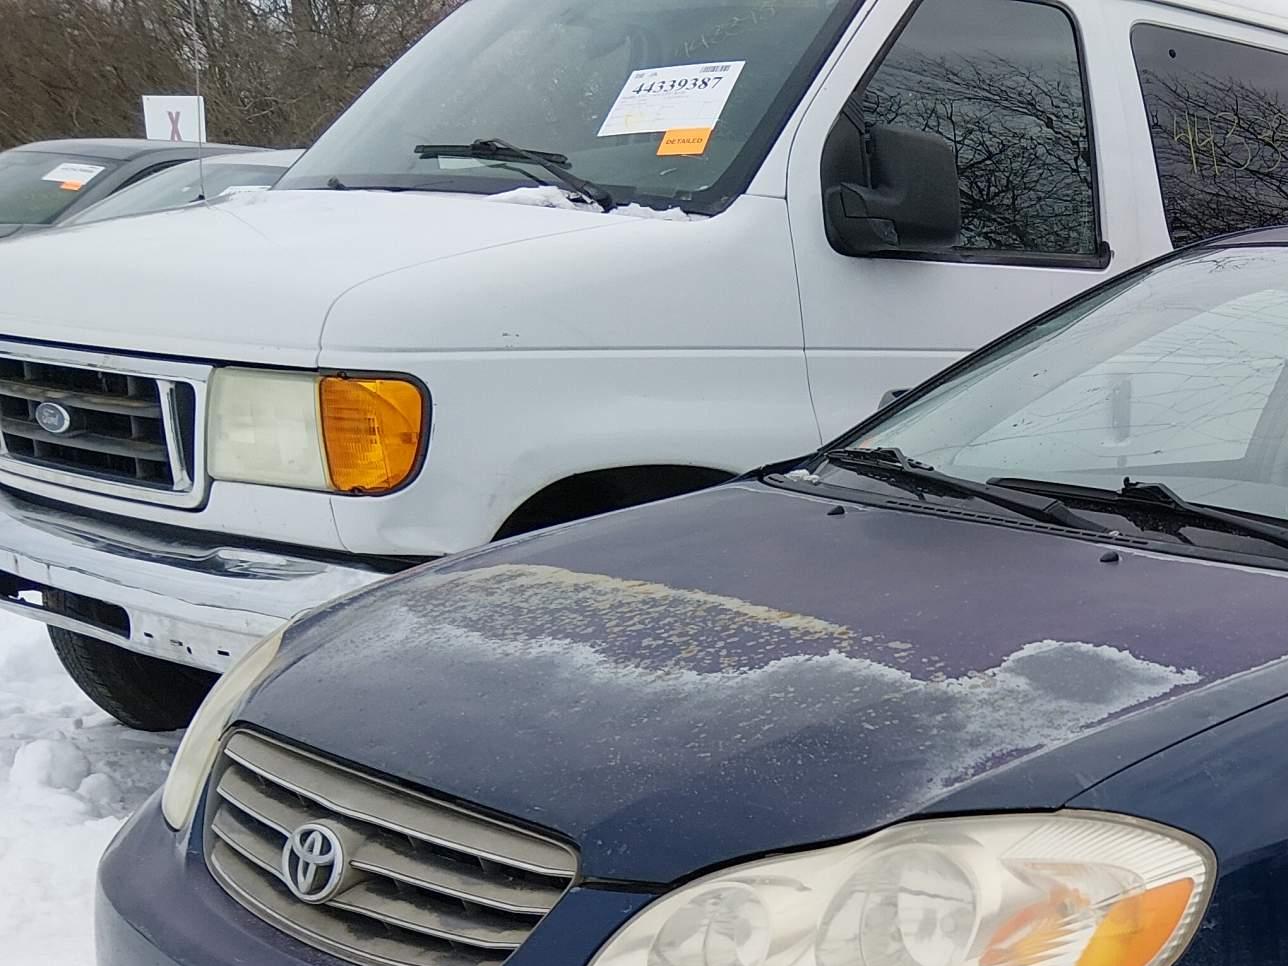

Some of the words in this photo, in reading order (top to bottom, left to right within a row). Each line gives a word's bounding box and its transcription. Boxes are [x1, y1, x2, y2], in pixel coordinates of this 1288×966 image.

[632, 76, 724, 95] 44339387
[167, 111, 183, 142] X
[665, 137, 703, 145] DETAILED
